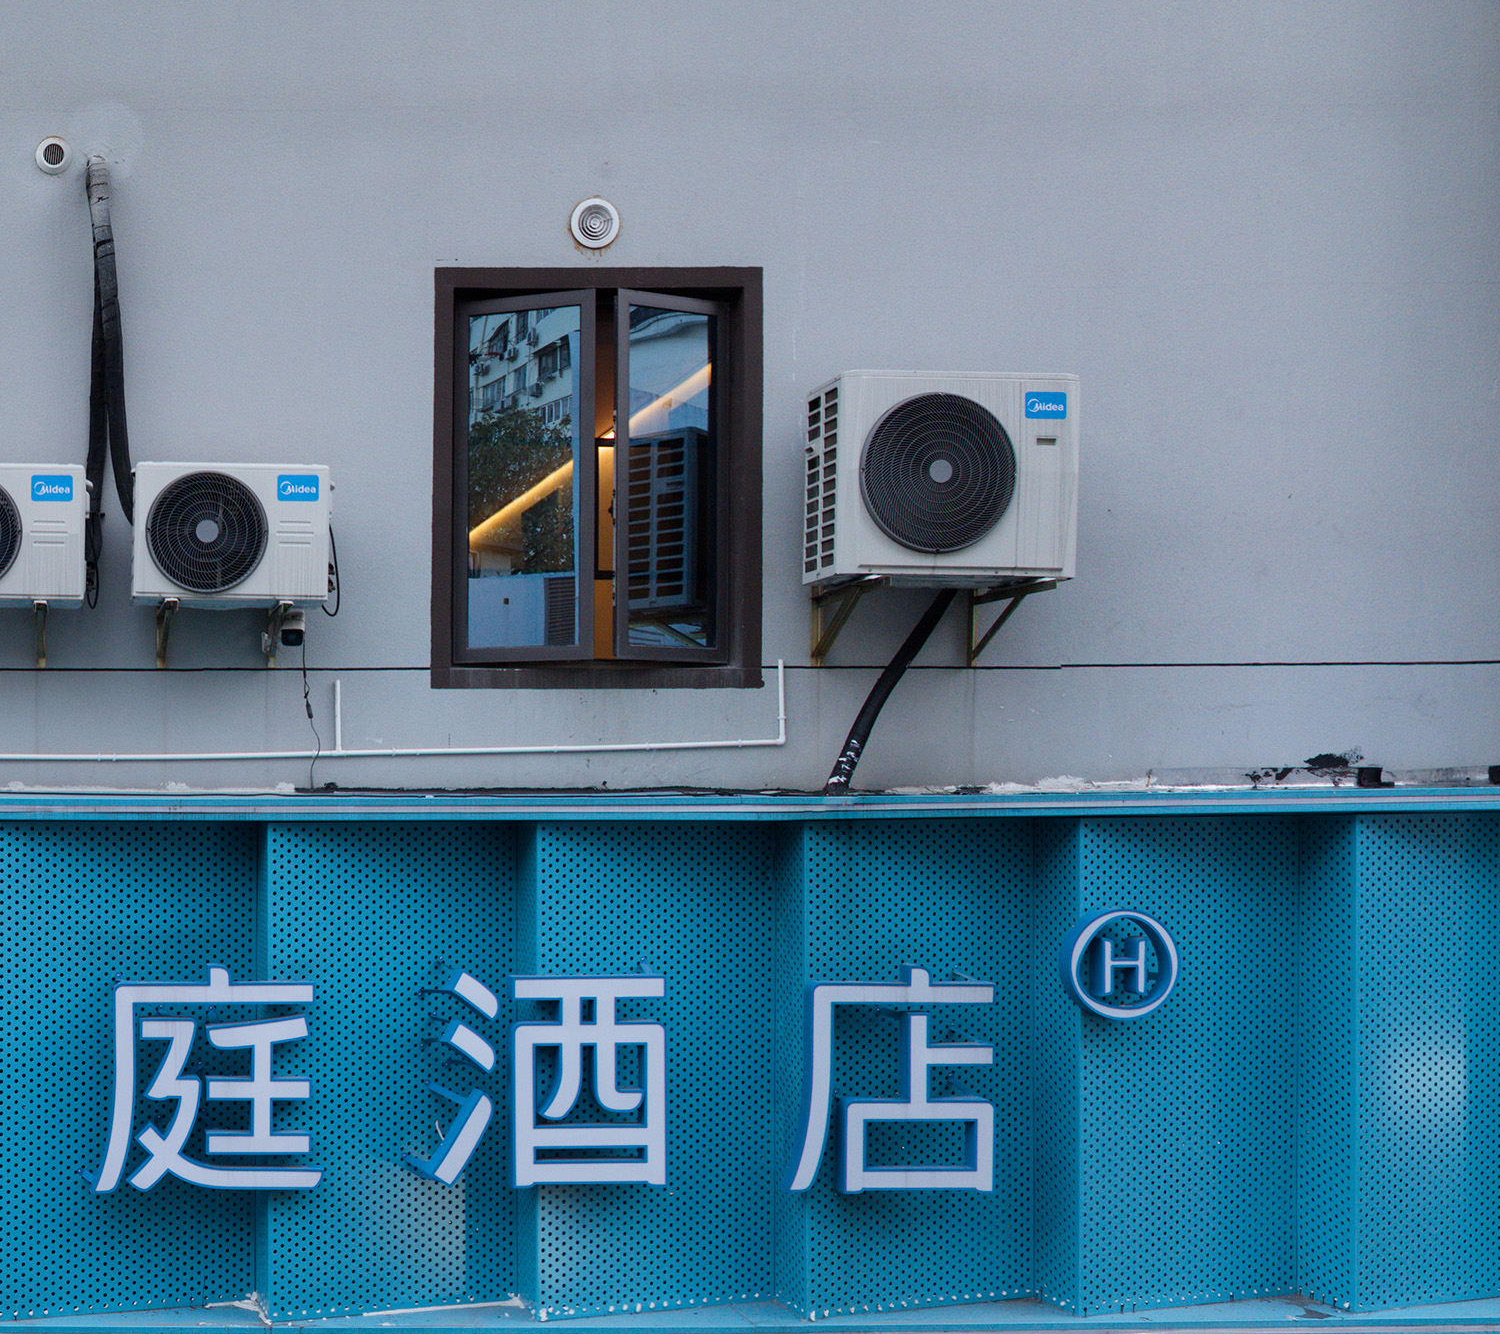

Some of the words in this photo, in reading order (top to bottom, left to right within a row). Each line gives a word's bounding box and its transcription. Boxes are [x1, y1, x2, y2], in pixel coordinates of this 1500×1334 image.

[1028, 399, 1064, 412] Midea
[34, 481, 70, 495] Midea
[280, 481, 316, 495] Midea
